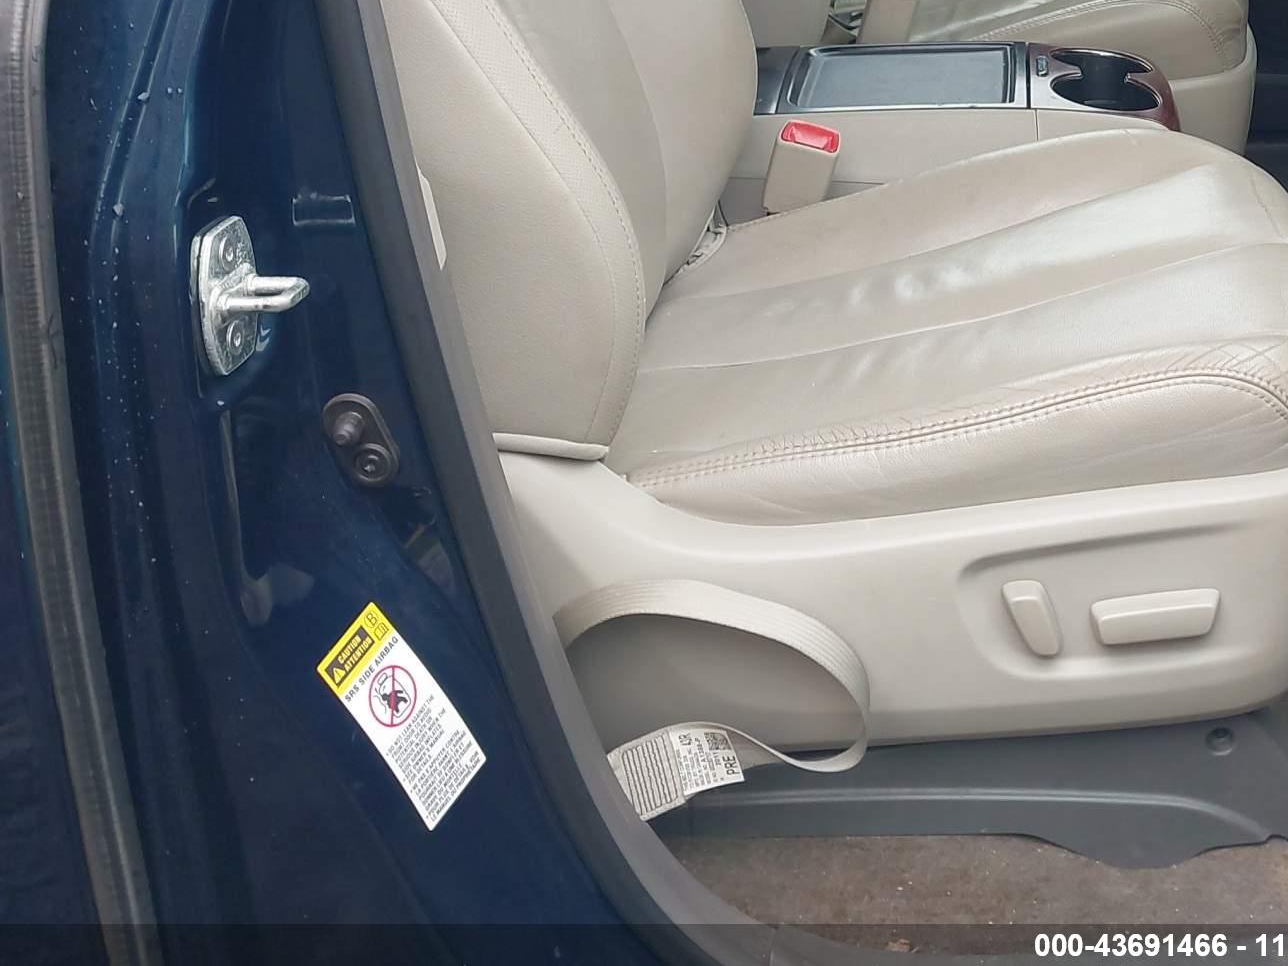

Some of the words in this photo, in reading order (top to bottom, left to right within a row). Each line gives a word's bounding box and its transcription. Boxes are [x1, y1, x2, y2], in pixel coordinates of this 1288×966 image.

[337, 633, 362, 665] CAUTION
[342, 635, 373, 673] ATTENTION
[344, 683, 360, 704] SRS
[358, 664, 376, 686] SIDE
[373, 634, 399, 667] AIRBAG
[722, 755, 740, 775] PRE
